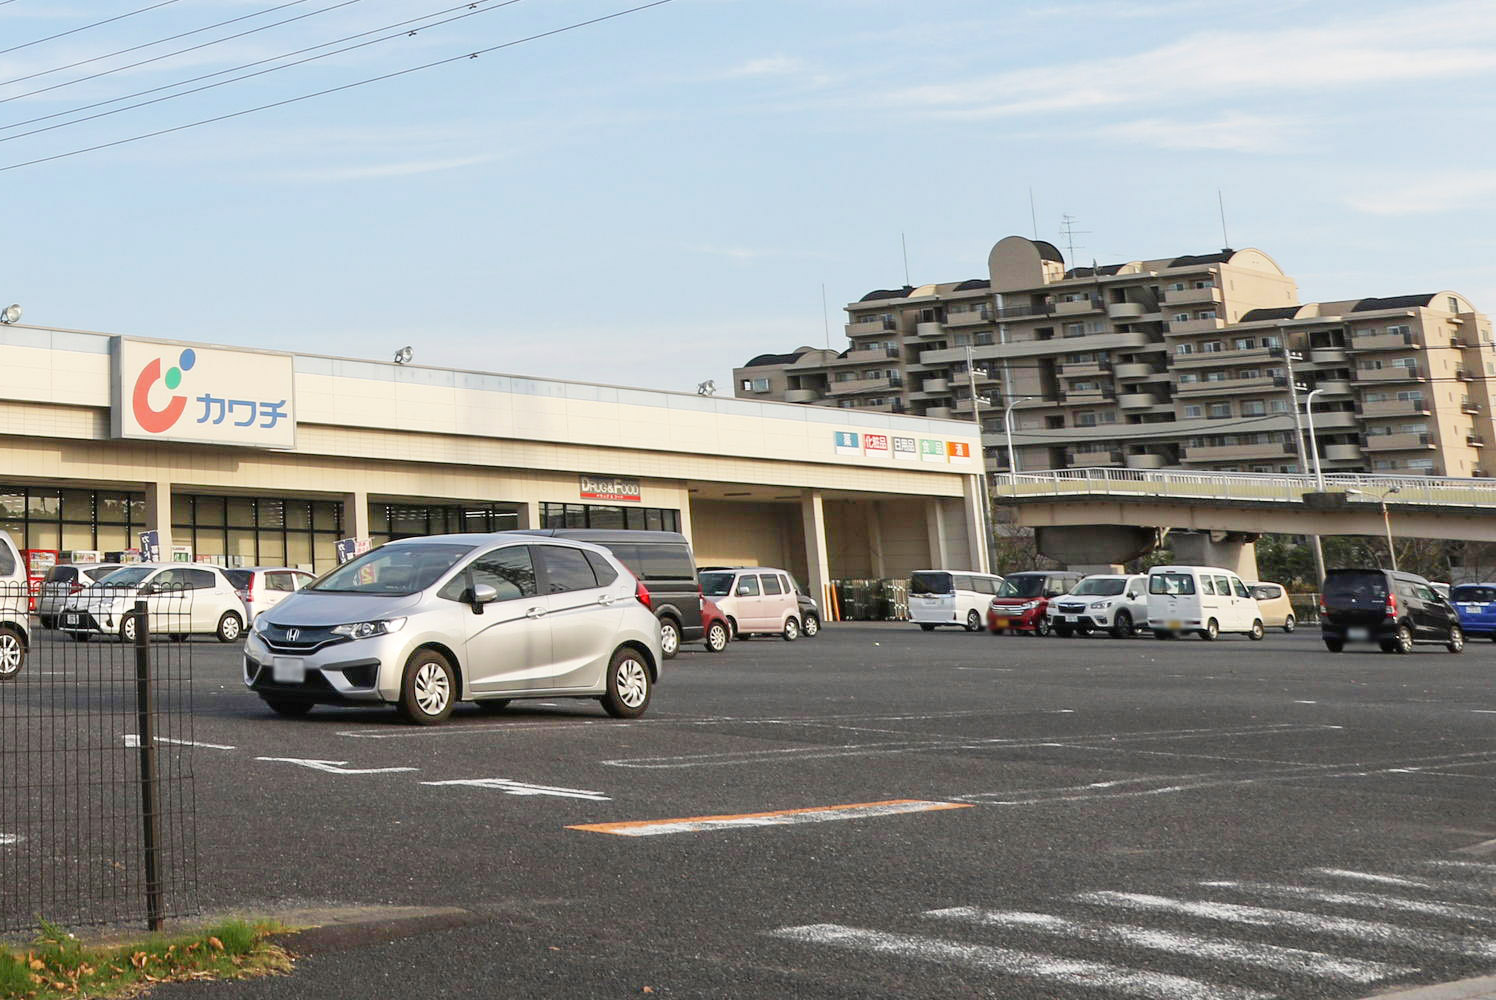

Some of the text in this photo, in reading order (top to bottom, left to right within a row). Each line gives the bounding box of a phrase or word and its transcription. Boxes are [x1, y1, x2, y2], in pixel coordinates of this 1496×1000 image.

[196, 393, 287, 428] カワチ
[865, 435, 887, 449] 化粧品
[894, 438, 915, 452] 日用品
